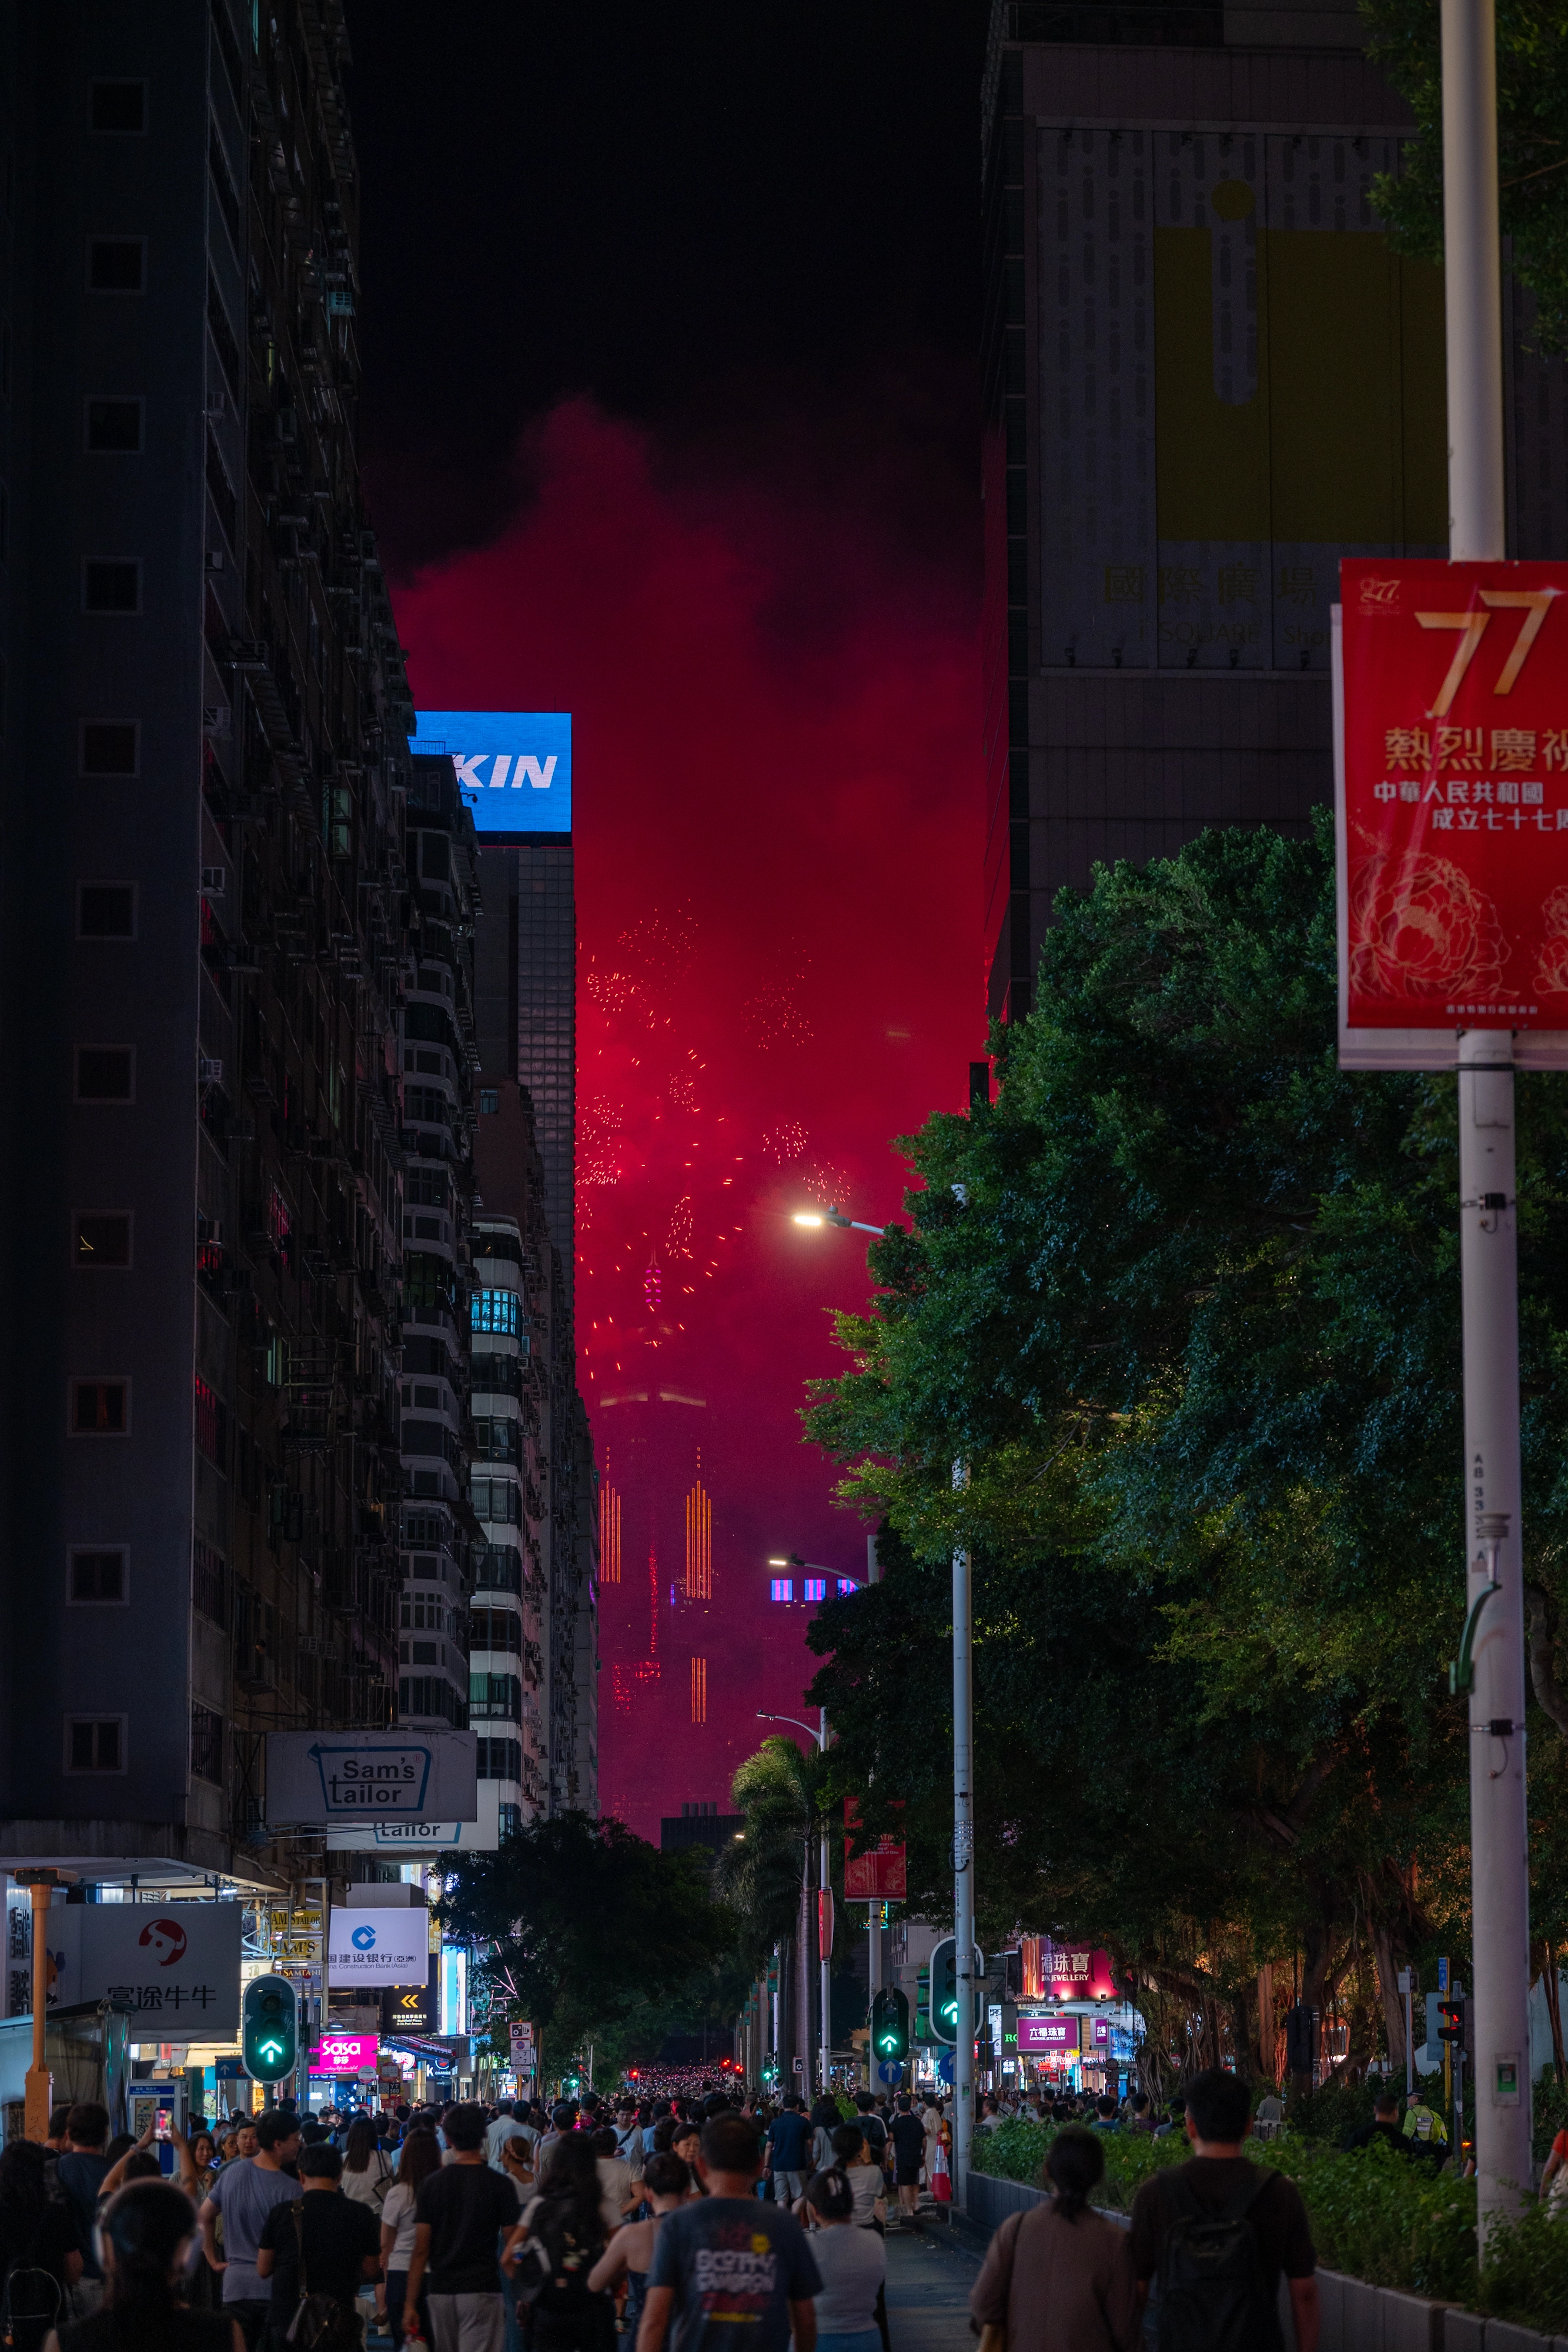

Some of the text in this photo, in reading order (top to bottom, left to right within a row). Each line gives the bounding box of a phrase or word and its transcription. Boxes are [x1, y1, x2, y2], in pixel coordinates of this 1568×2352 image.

[1104, 562, 1317, 606] 國際廣場
[1414, 589, 1557, 719] 77
[1373, 780, 1544, 804] 中華人民共和國
[343, 1757, 415, 1779] Sam's
[330, 1775, 402, 1803] tailor
[296, 1916, 320, 1925] TAILOR
[283, 1969, 320, 1977] SAMTANI
[1051, 1974, 1089, 1983] JEWELLERY
[108, 1986, 217, 2010] 富途牛牛
[1029, 2027, 1066, 2037] 六福珠寶
